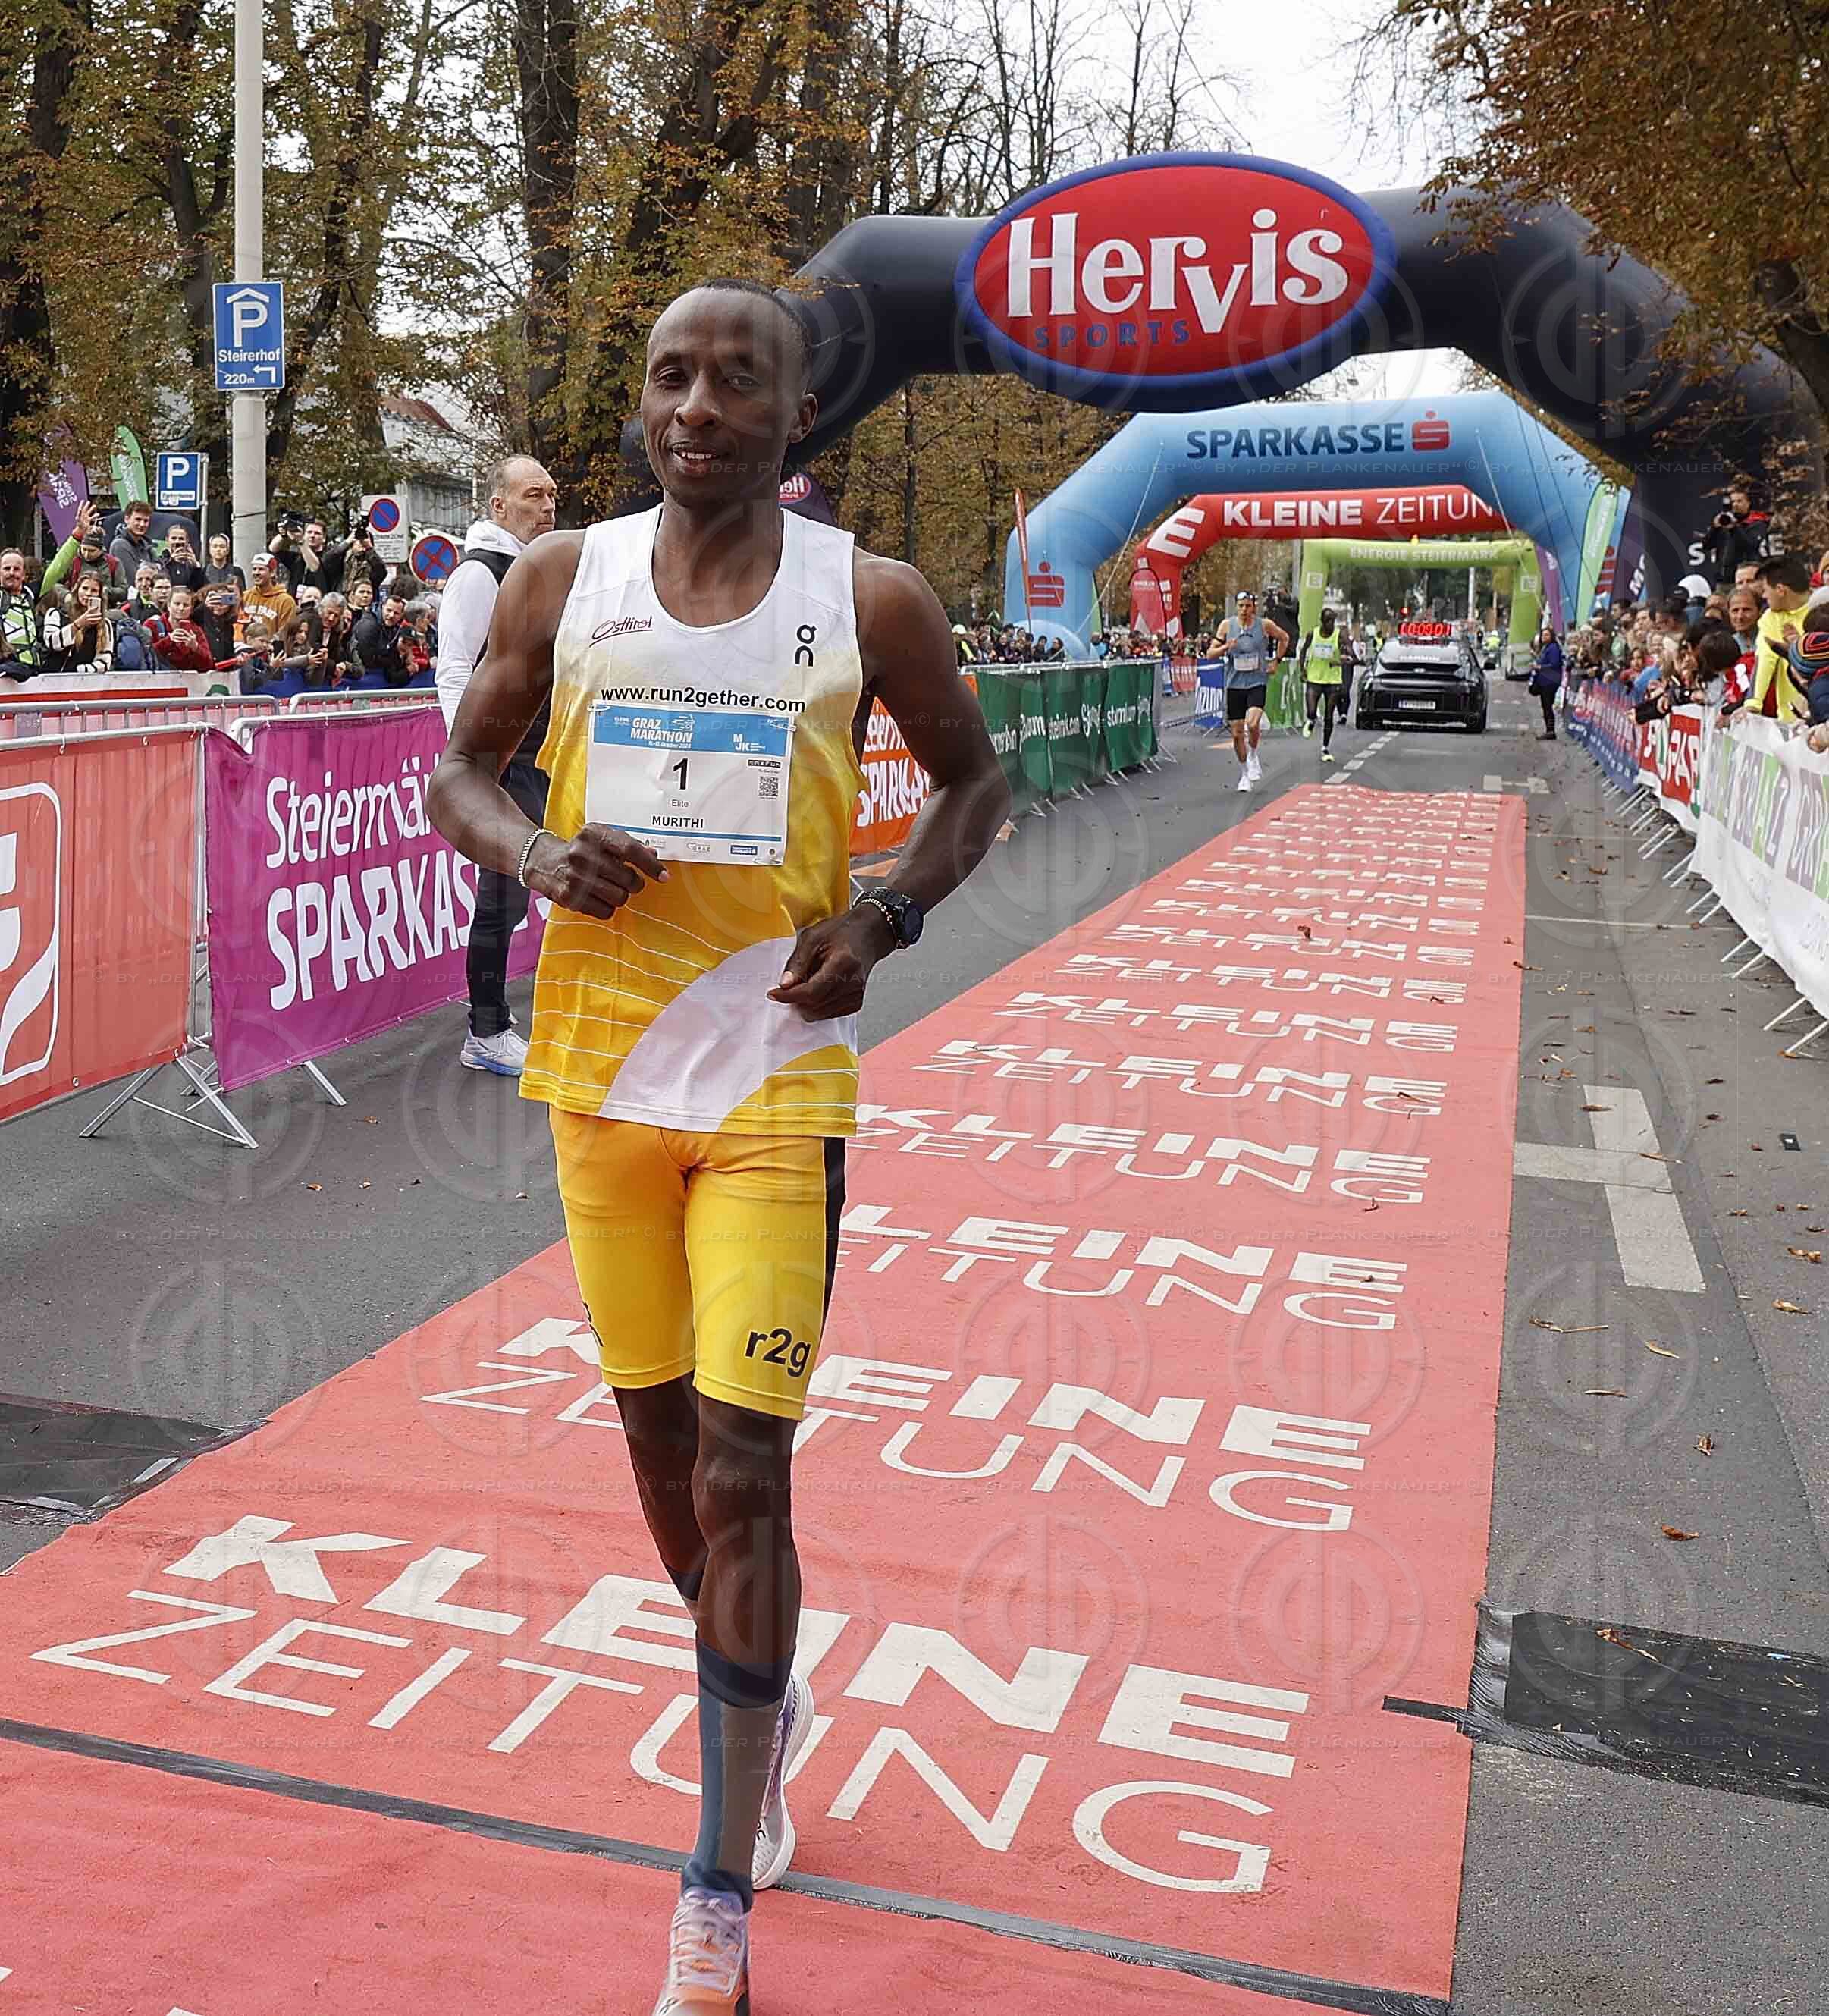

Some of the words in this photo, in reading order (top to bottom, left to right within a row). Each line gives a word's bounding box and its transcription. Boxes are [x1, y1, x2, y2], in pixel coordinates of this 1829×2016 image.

[1007, 209, 1350, 334] Hervis
[233, 301, 268, 347] P
[1035, 320, 1190, 349] SPORTS
[218, 348, 280, 362] Steirerhof
[1187, 422, 1404, 458] SPARKASSE
[1223, 498, 1363, 528] KLEINE
[1349, 545, 1407, 559] ENERGIE
[1412, 548, 1497, 561] STEIERMARK
[601, 686, 806, 713] www.run2gether.com
[631, 727, 692, 743] MARATHON
[632, 717, 662, 730] GRAZ
[673, 758, 688, 790] 1
[672, 799, 689, 808] Elite
[652, 815, 704, 828] MURITHI
[267, 850, 481, 1010] SPARKAS
[1007, 991, 1458, 1035] KLEINE
[934, 1039, 1448, 1097] KLEINE
[911, 1055, 1442, 1116] ZEITUNG
[855, 1104, 1431, 1179] KLEINE
[839, 1203, 1408, 1292] LEINE
[744, 1327, 811, 1378] r2g
